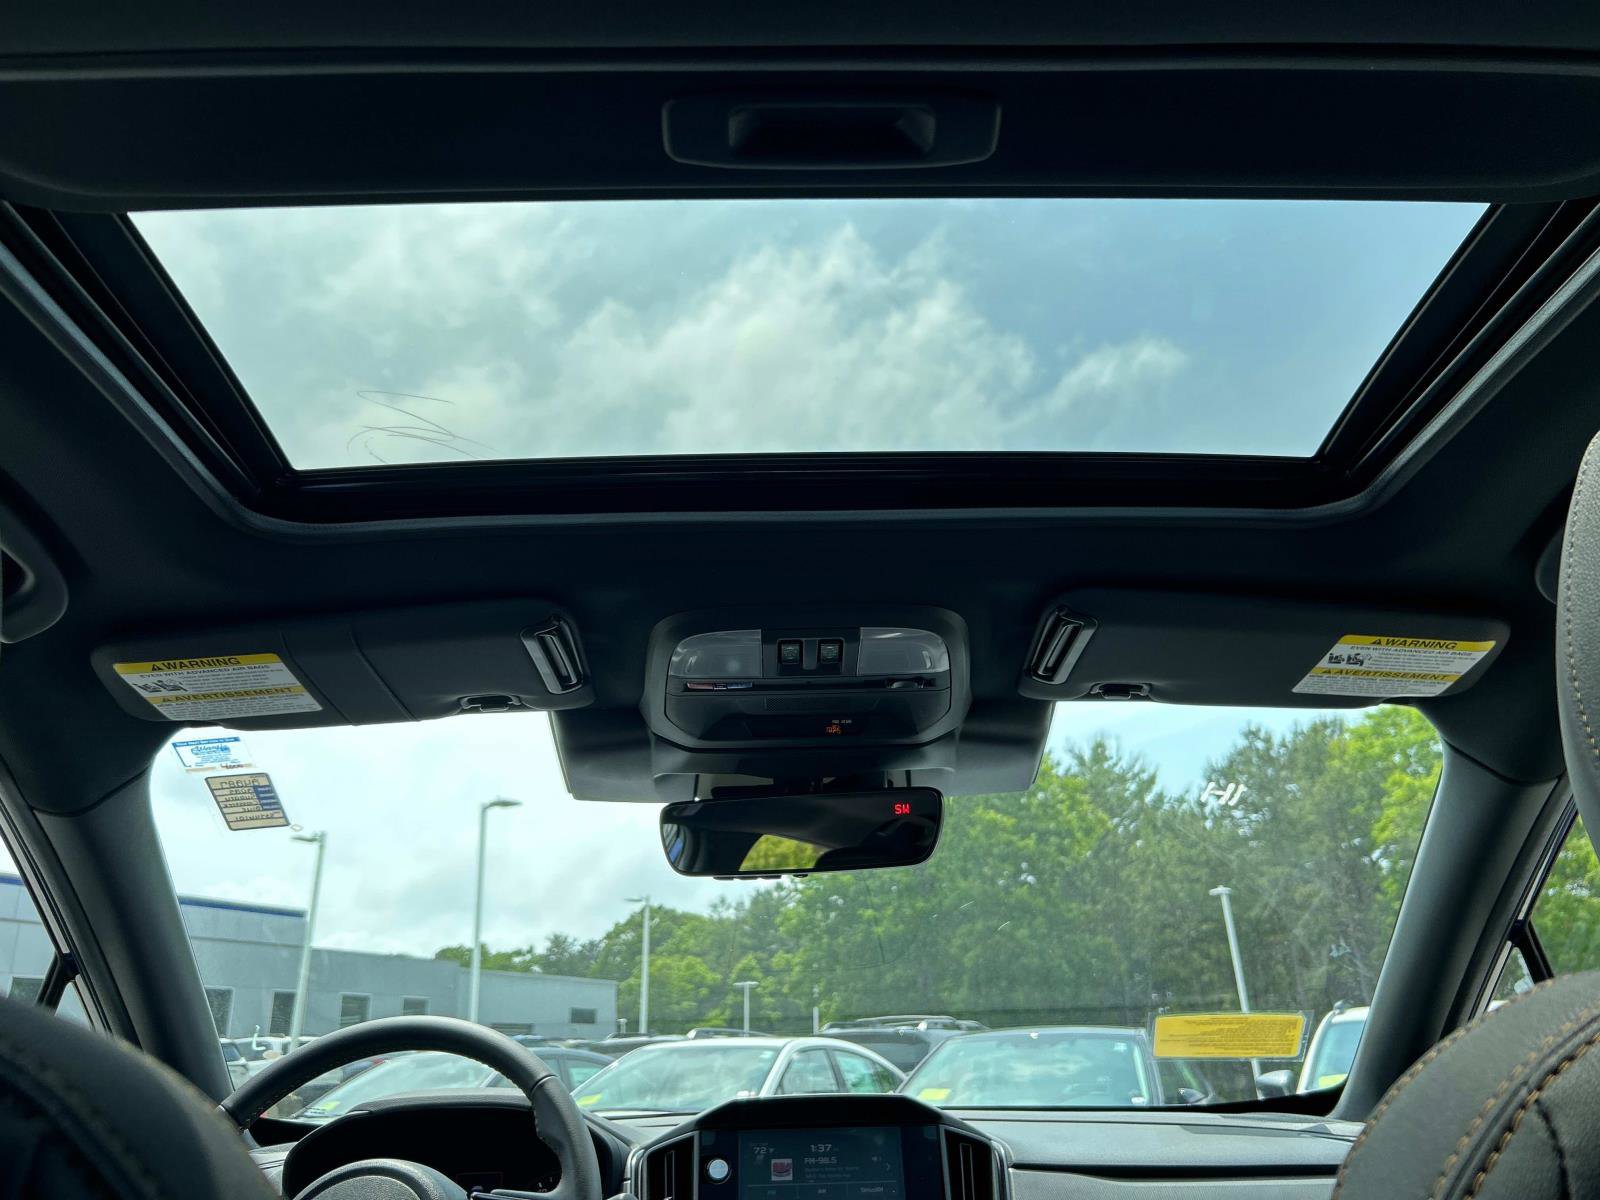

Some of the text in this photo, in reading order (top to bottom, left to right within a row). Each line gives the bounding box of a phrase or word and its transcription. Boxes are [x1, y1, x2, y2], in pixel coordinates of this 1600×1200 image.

[1384, 638, 1458, 650] WARNING
[162, 657, 241, 671] WARNING
[185, 667, 230, 675] ADVANCED
[1332, 668, 1451, 680] AVERTISSEMENT
[173, 687, 294, 702] AVERTISSEMENT
[894, 803, 910, 815] SW
[809, 1144, 833, 1152] 1:37
